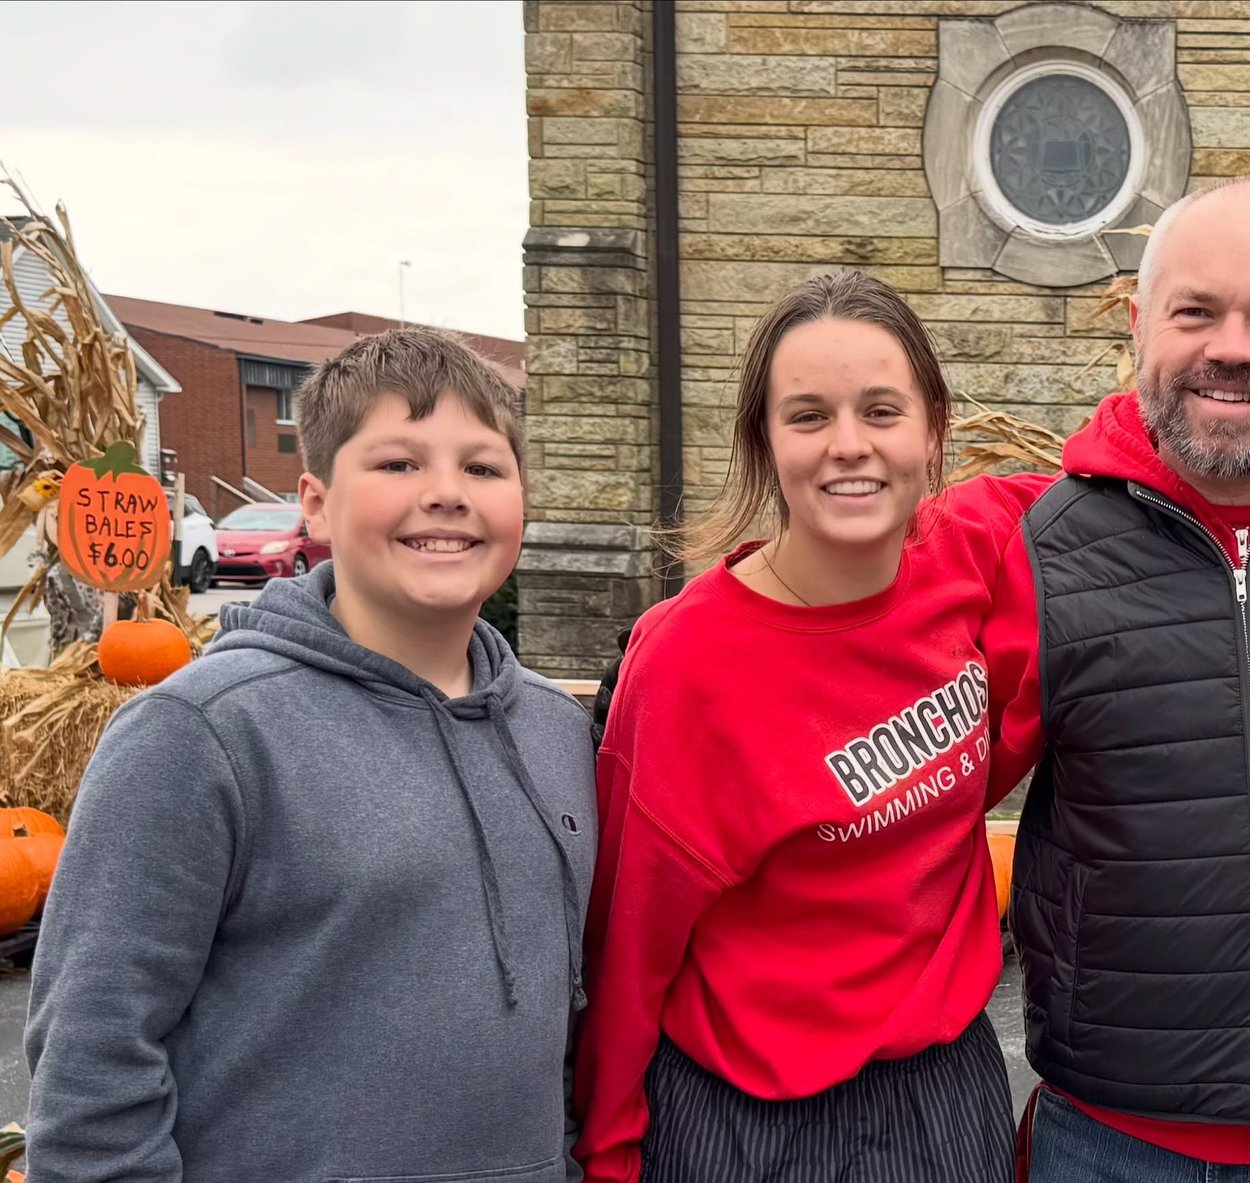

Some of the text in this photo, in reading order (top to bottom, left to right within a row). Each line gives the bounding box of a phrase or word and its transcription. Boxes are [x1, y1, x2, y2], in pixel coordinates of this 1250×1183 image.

[77, 487, 158, 515] STRAW
[86, 514, 154, 539] BALES
[87, 541, 149, 571] $6.00
[824, 661, 988, 807] BRONCHOS
[816, 766, 957, 843] SWIMMING
[960, 752, 975, 777] &
